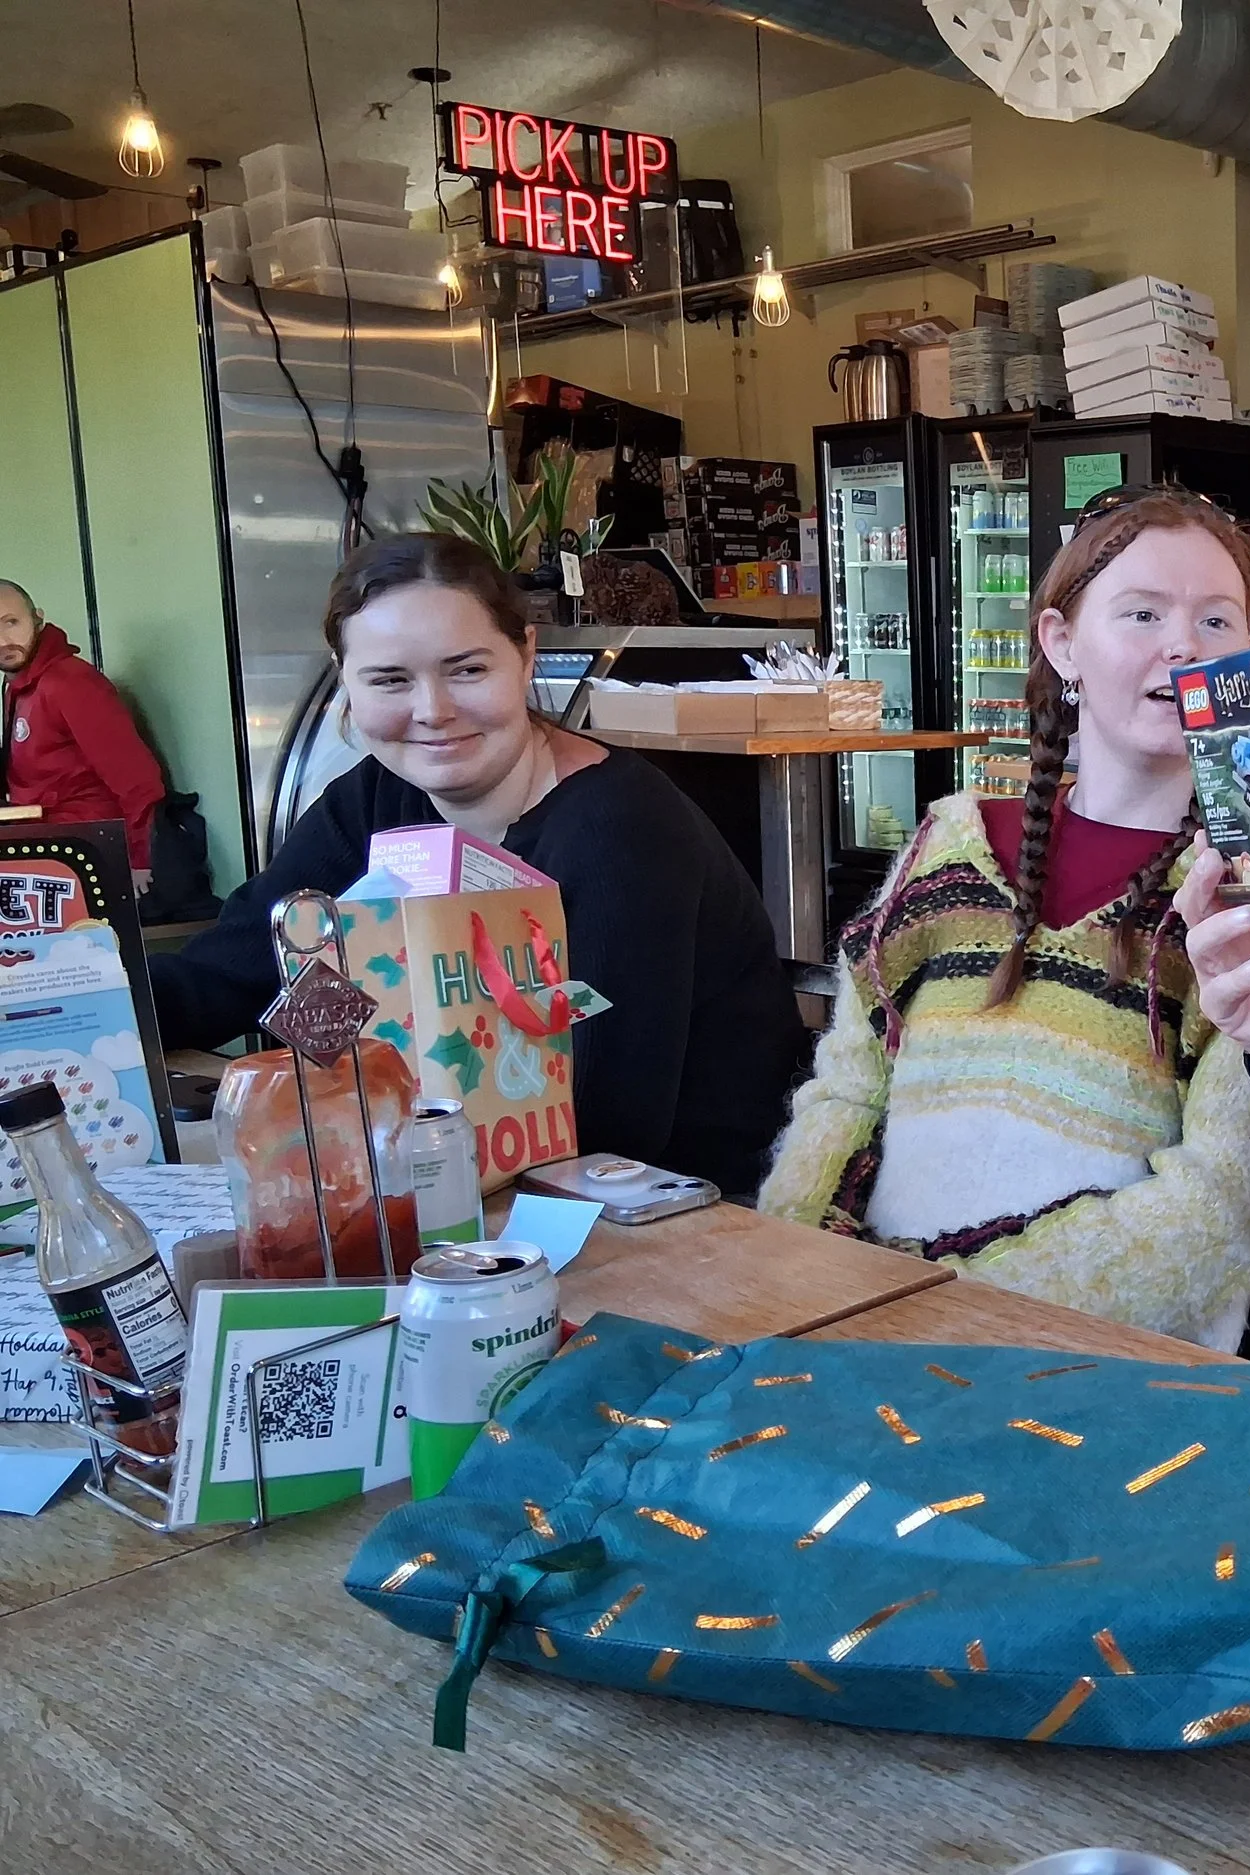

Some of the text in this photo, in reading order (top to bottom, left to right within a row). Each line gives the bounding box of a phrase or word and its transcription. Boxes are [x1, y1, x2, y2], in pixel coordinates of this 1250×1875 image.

[457, 105, 667, 196] PICK UP
[495, 180, 633, 260] HERE
[841, 464, 898, 476] BOYLAN BOTTLING
[1185, 689, 1208, 711] LEGO
[1190, 738, 1206, 756] 7+
[372, 842, 420, 855] SO MUCH
[371, 852, 430, 866] MORE THAN
[57, 966, 77, 975] about
[1, 986, 24, 996] makes
[25, 985, 37, 993] the
[39, 981, 71, 993] products
[72, 980, 85, 988] you
[494, 1016, 547, 1100] &
[146, 1265, 163, 1281] Facts
[122, 1311, 163, 1335] Calories
[219, 1363, 240, 1471] OrderWithToast.com
[239, 1405, 248, 1433] scan?
[183, 1476, 191, 1488] by
[179, 1501, 188, 1520] toast
